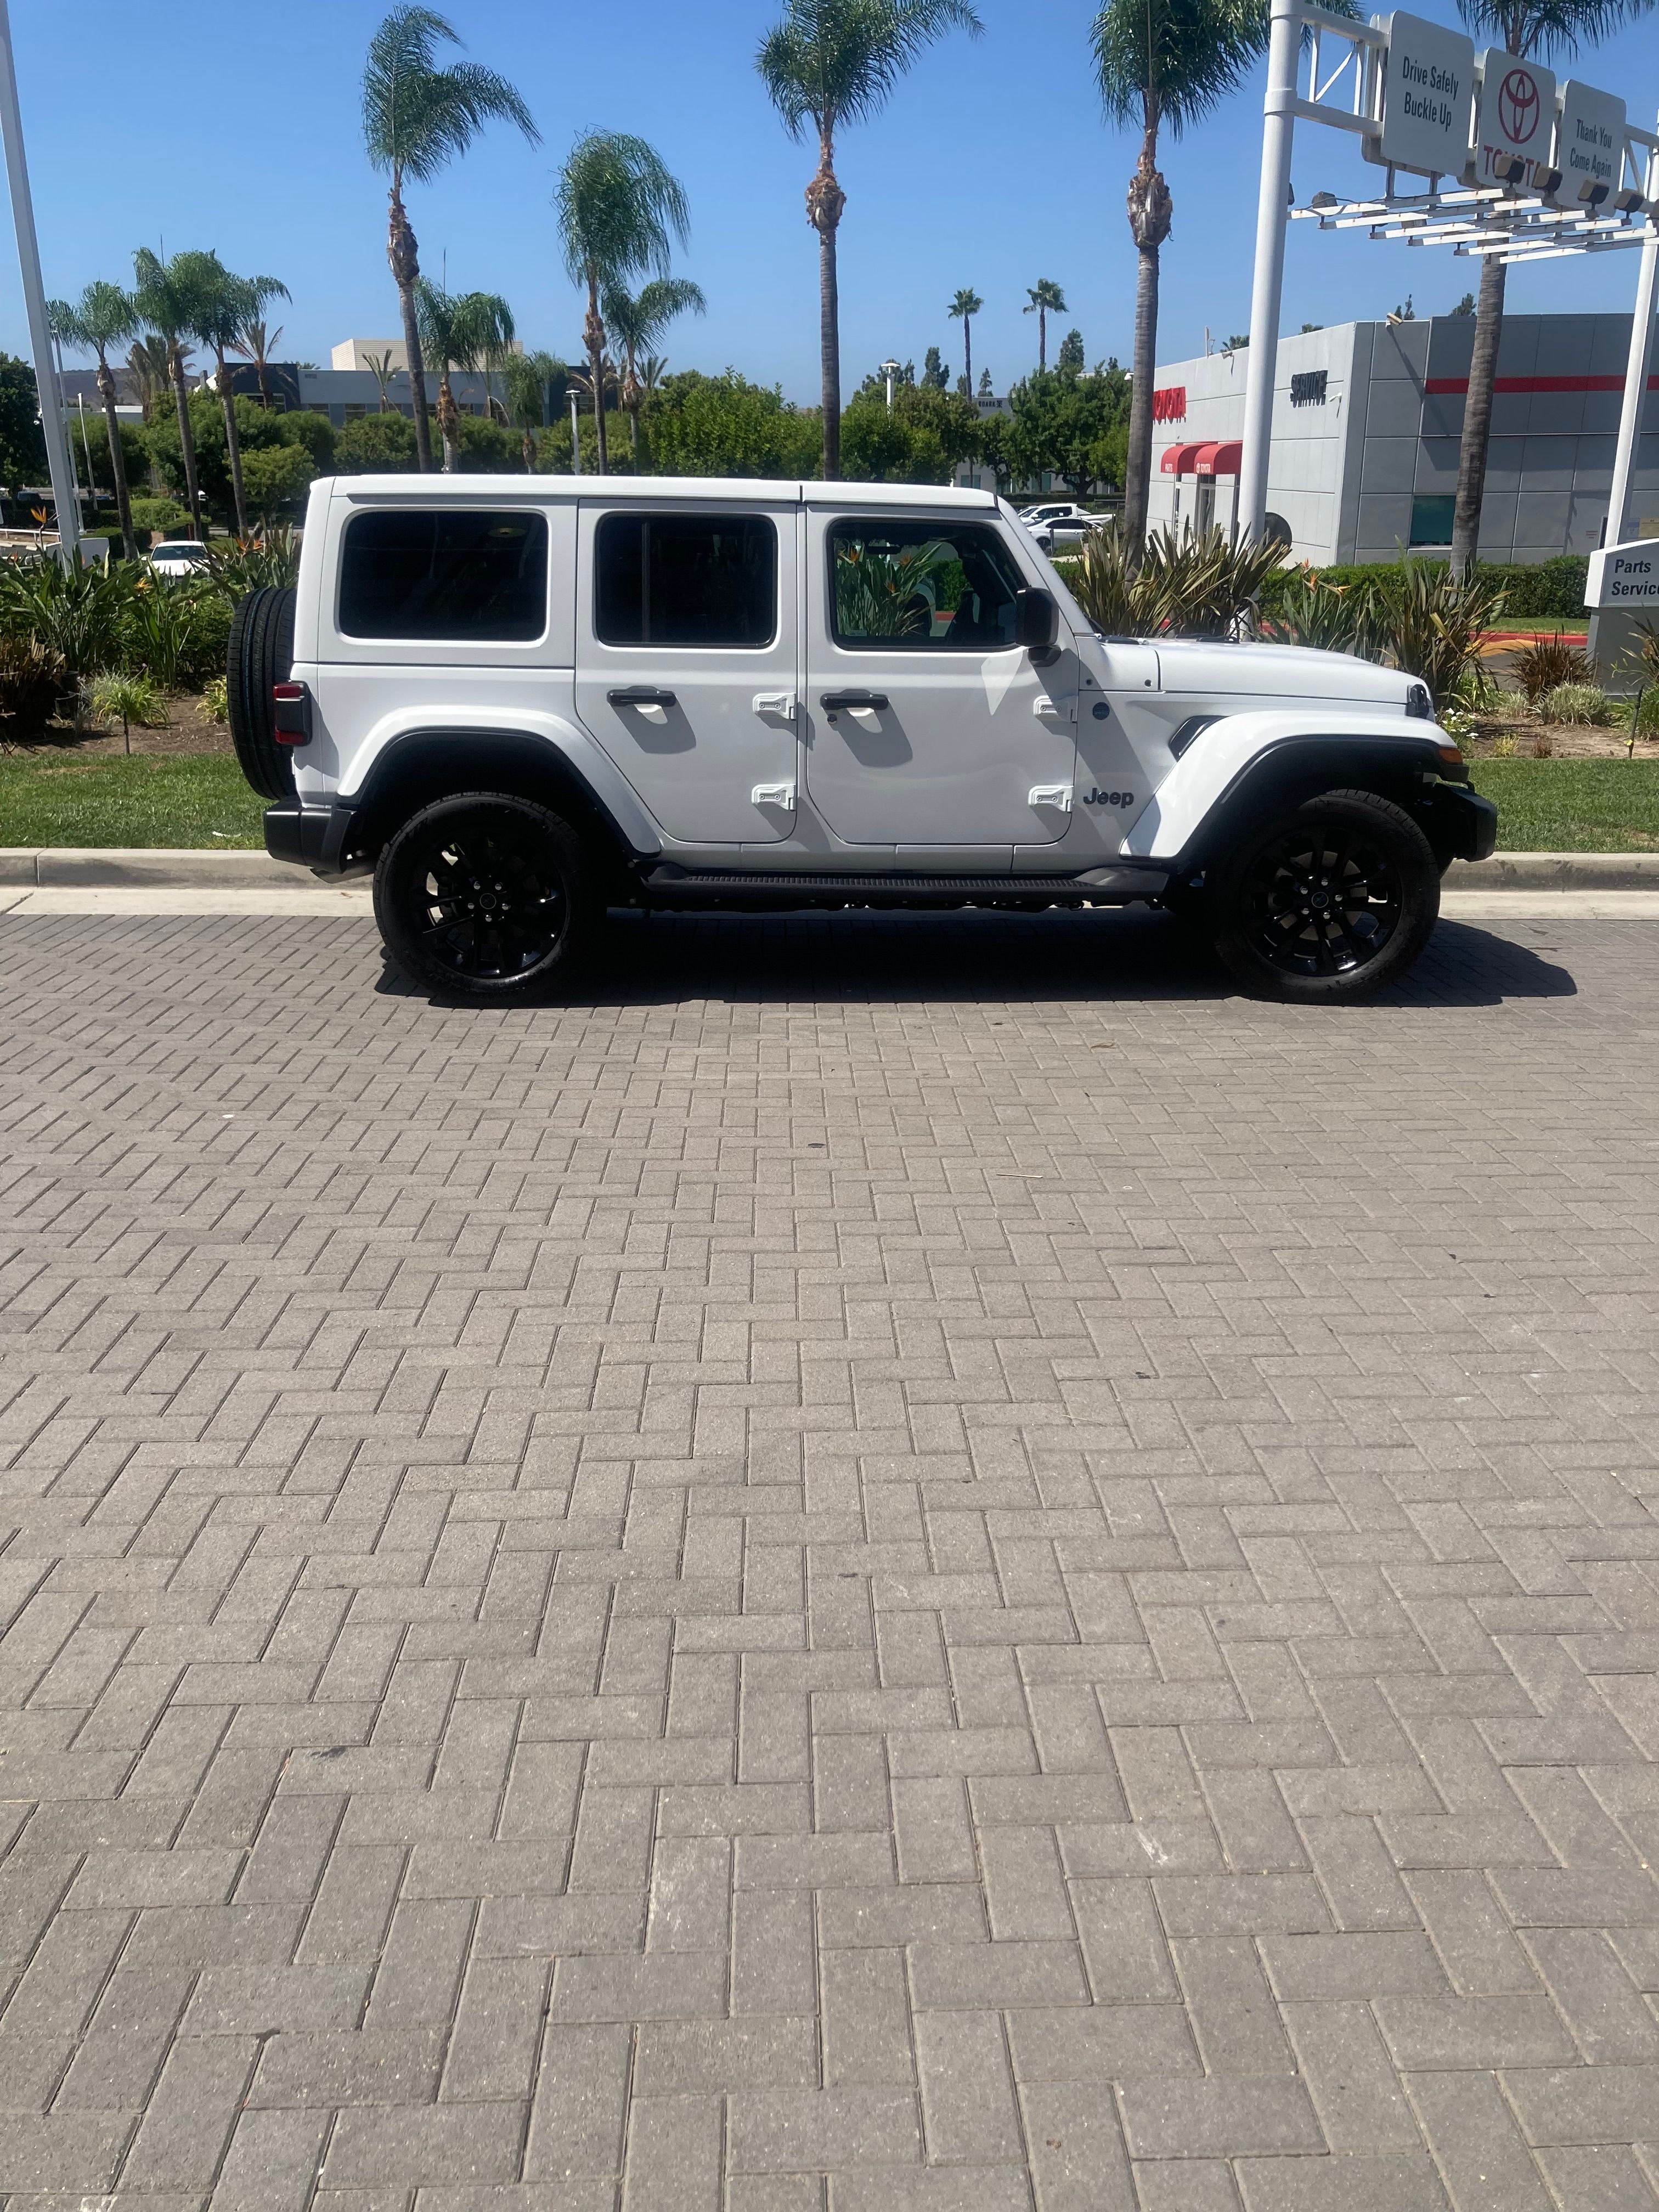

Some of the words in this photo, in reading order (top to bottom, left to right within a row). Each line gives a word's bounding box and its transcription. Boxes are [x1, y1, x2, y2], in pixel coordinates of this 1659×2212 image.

[1402, 56, 1427, 85] Drive
[1430, 66, 1459, 101] Safely
[1404, 92, 1437, 122] Buckle
[1440, 102, 1452, 132] Up
[1576, 119, 1598, 144] Thank
[1600, 127, 1612, 149] You
[1570, 147, 1590, 171] Come
[1591, 154, 1612, 179] Again
[1615, 559, 1651, 573] Parts
[1611, 581, 1659, 596] Servic
[1083, 787, 1134, 809] Jeep
